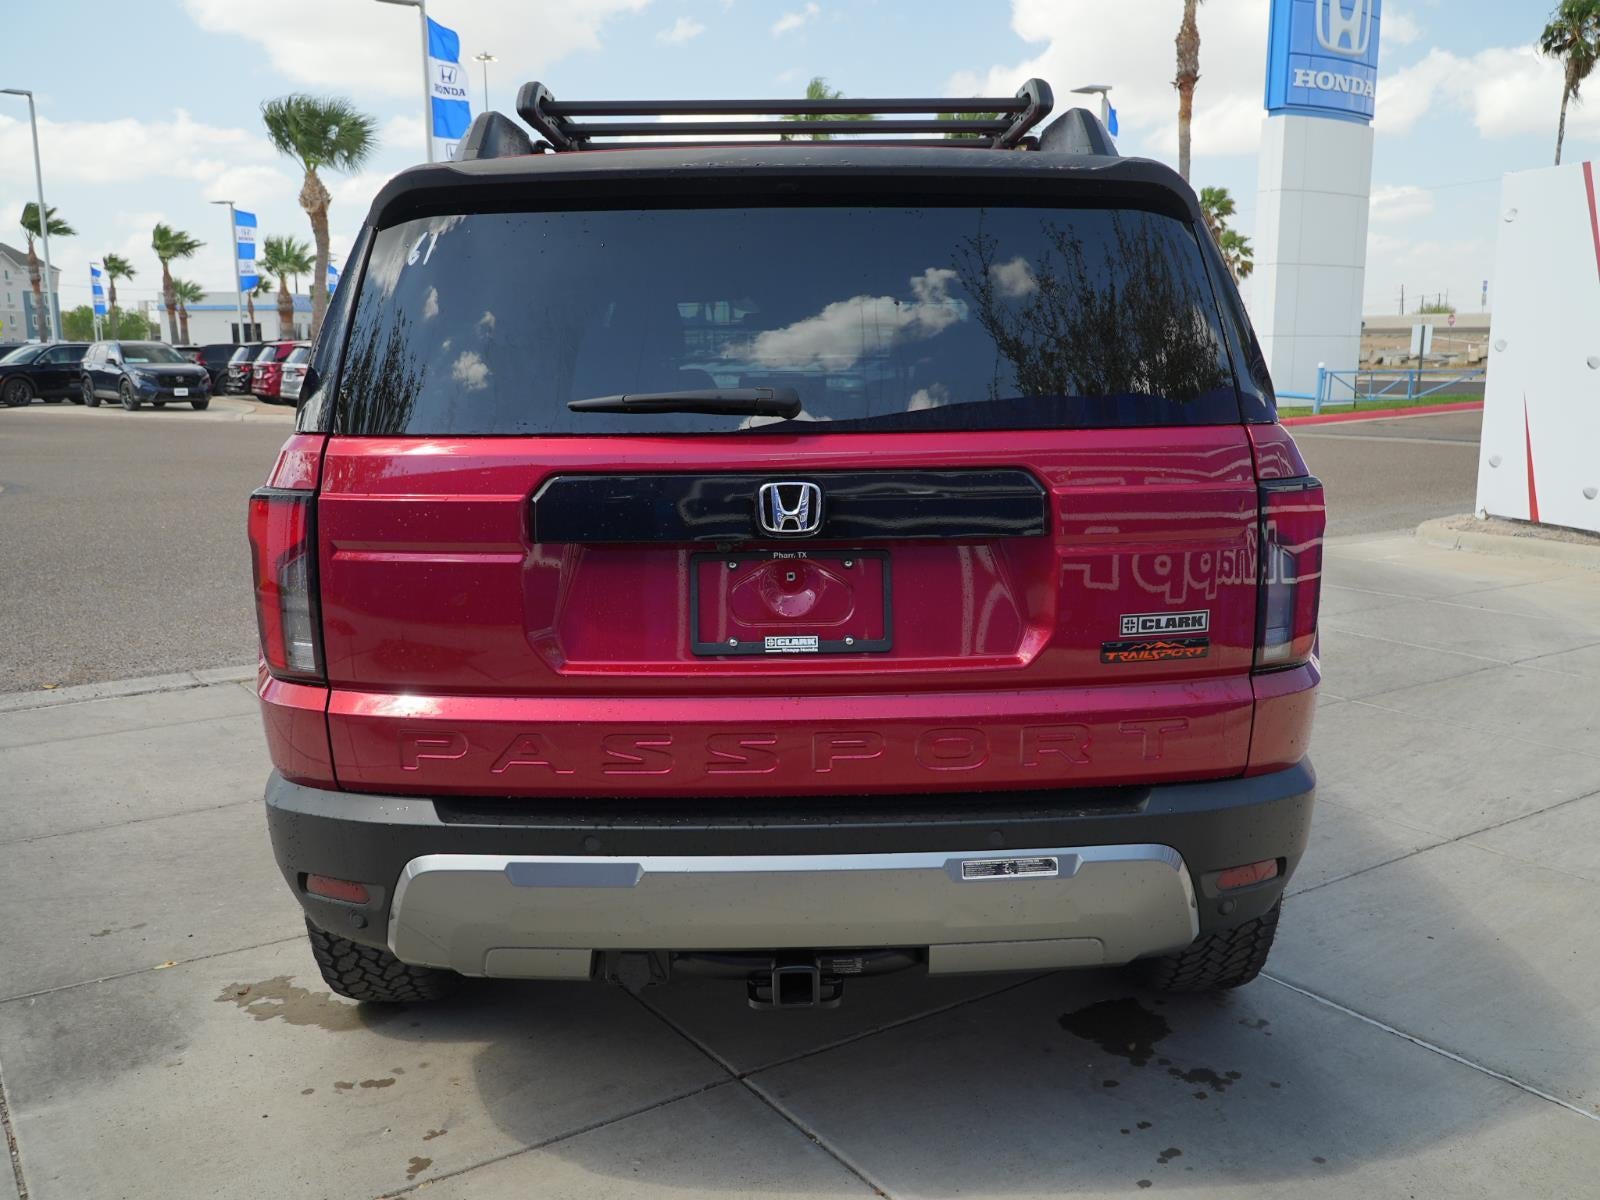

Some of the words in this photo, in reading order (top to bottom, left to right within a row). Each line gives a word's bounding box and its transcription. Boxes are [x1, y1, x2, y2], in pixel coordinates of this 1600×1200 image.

[434, 83, 466, 97] HONDA
[1292, 68, 1375, 98] HONDA
[797, 551, 808, 559] TX
[1140, 613, 1205, 631] CLARK
[777, 638, 817, 646] CLARK
[1105, 647, 1206, 662] TRAILSPORT
[400, 717, 1190, 775] PASSPORT
